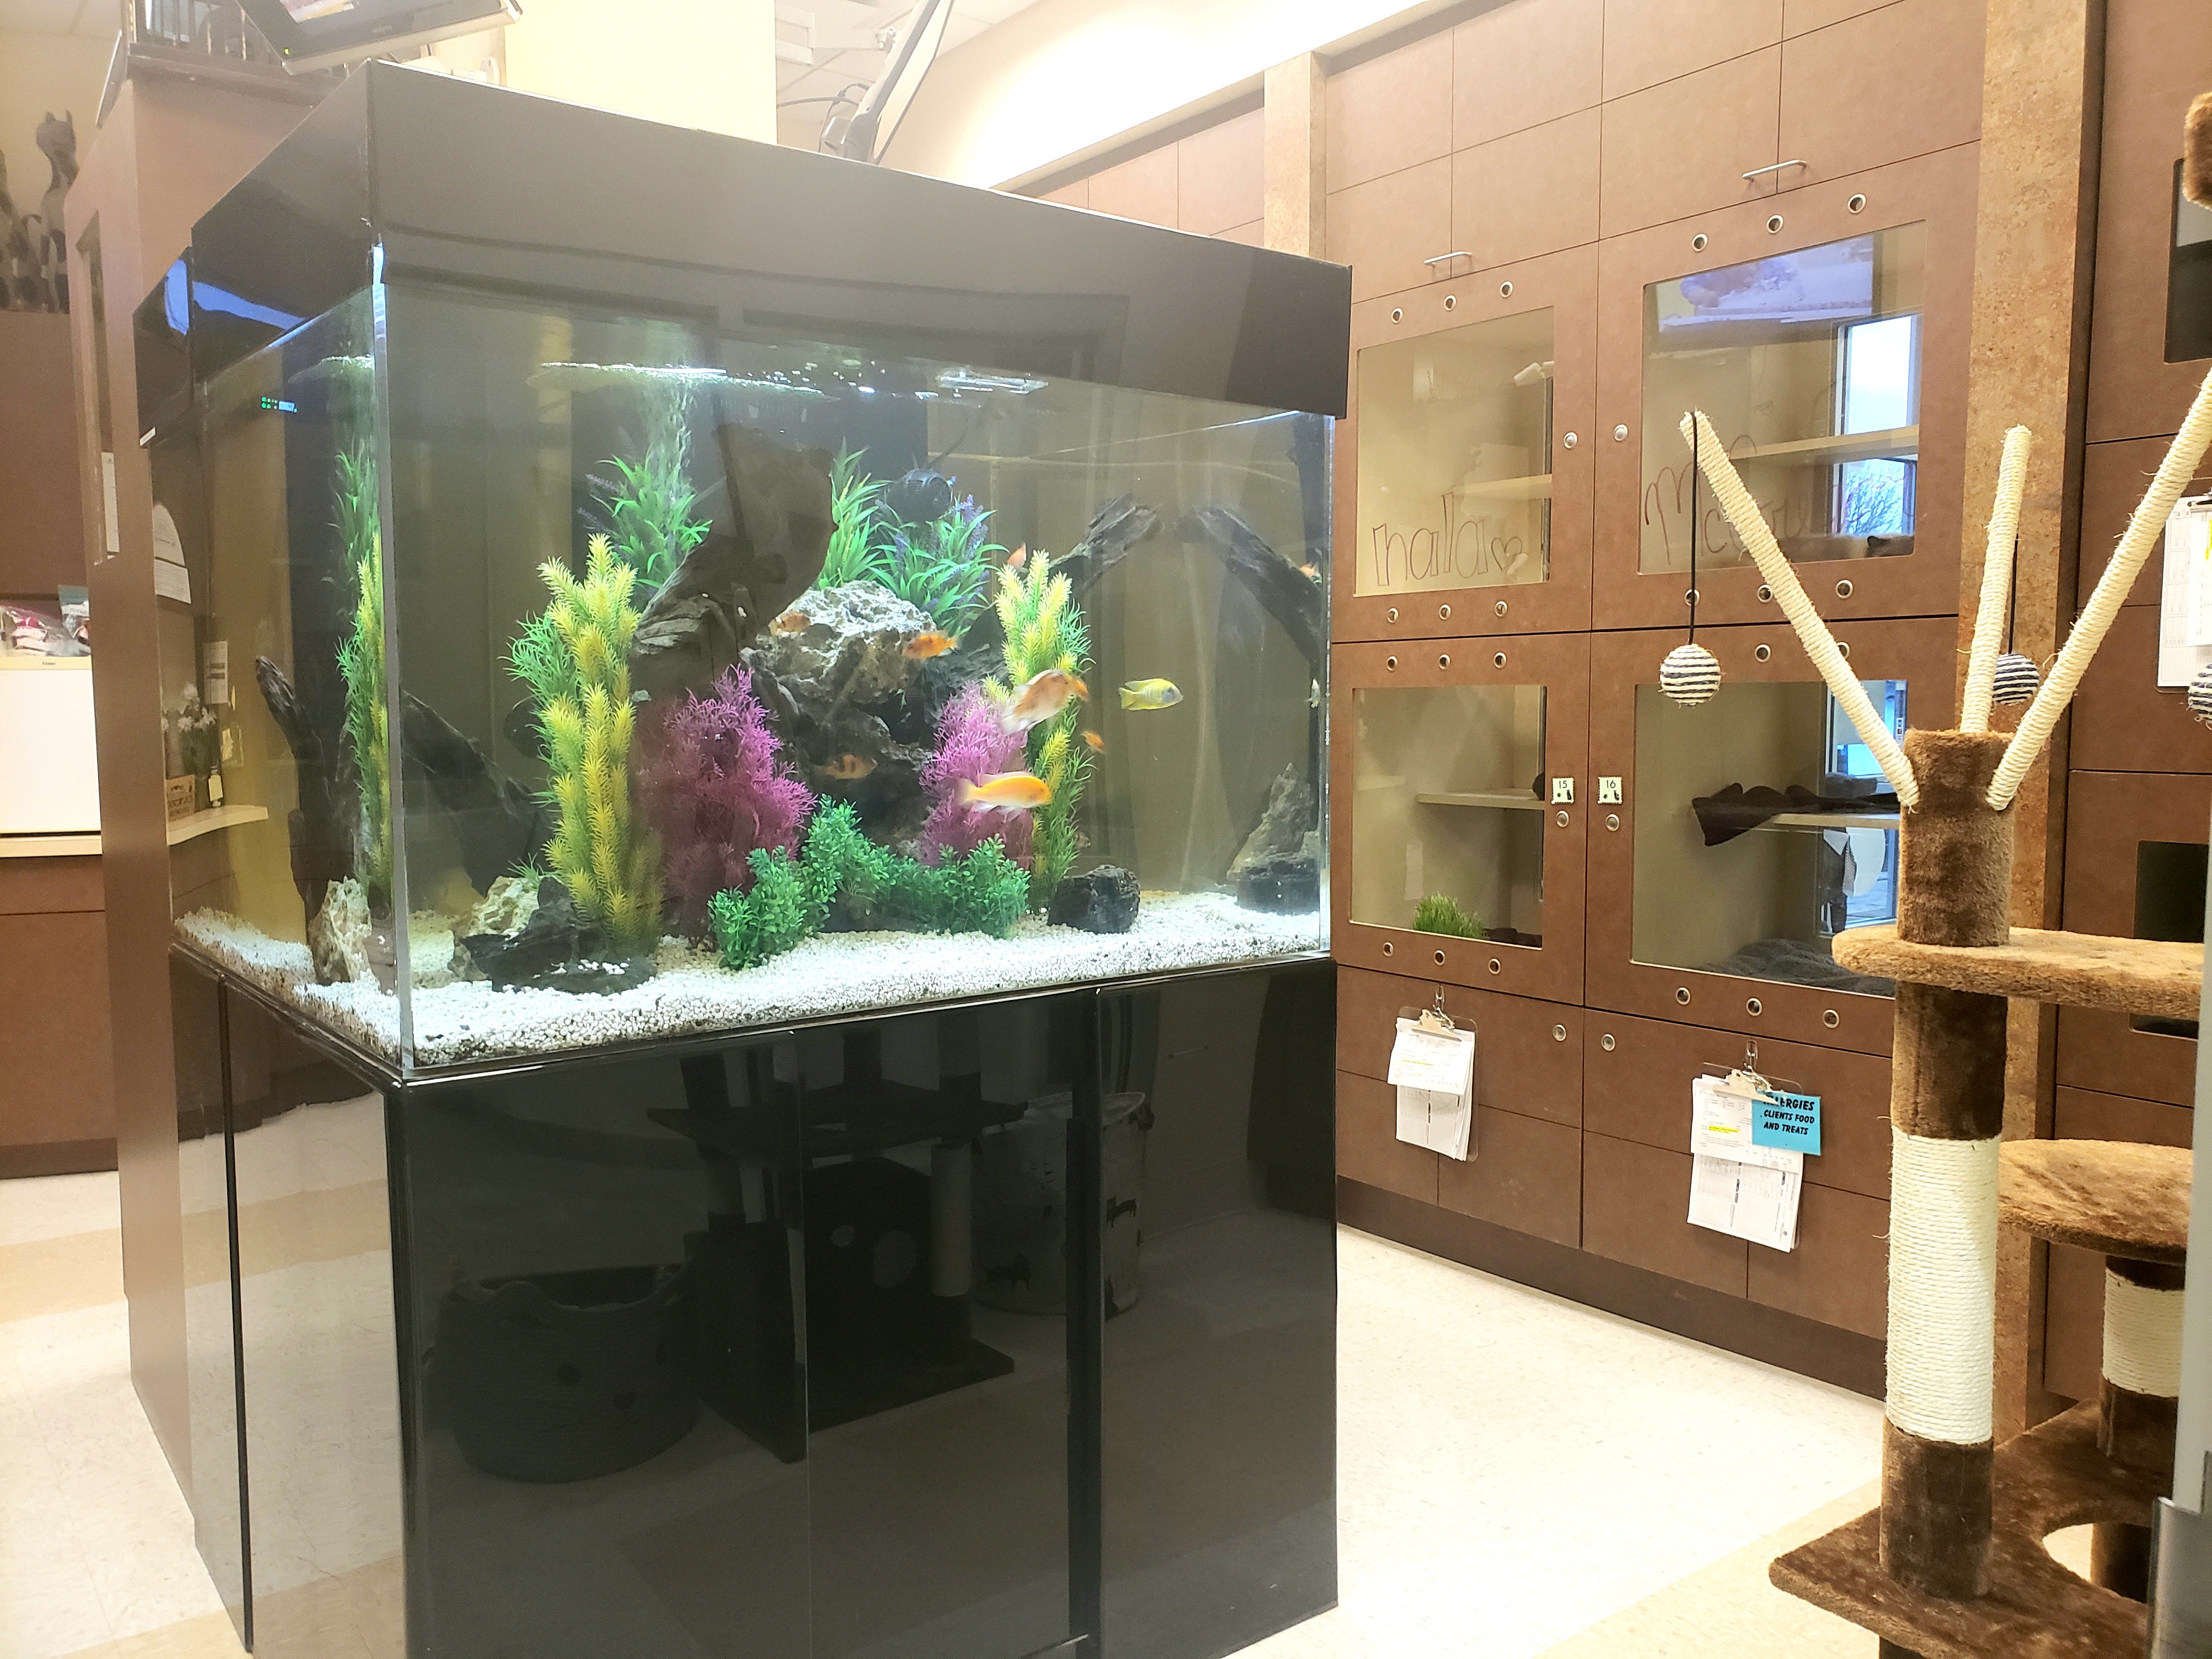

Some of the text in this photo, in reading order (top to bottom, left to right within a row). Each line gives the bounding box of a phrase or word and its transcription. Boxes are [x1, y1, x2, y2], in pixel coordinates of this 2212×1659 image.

[1559, 780, 1567, 789] 15
[1606, 780, 1616, 789] 16
[1764, 1109, 1815, 1124] CLIENTS FOOD
[1763, 1121, 1809, 1135] AND TREATS
